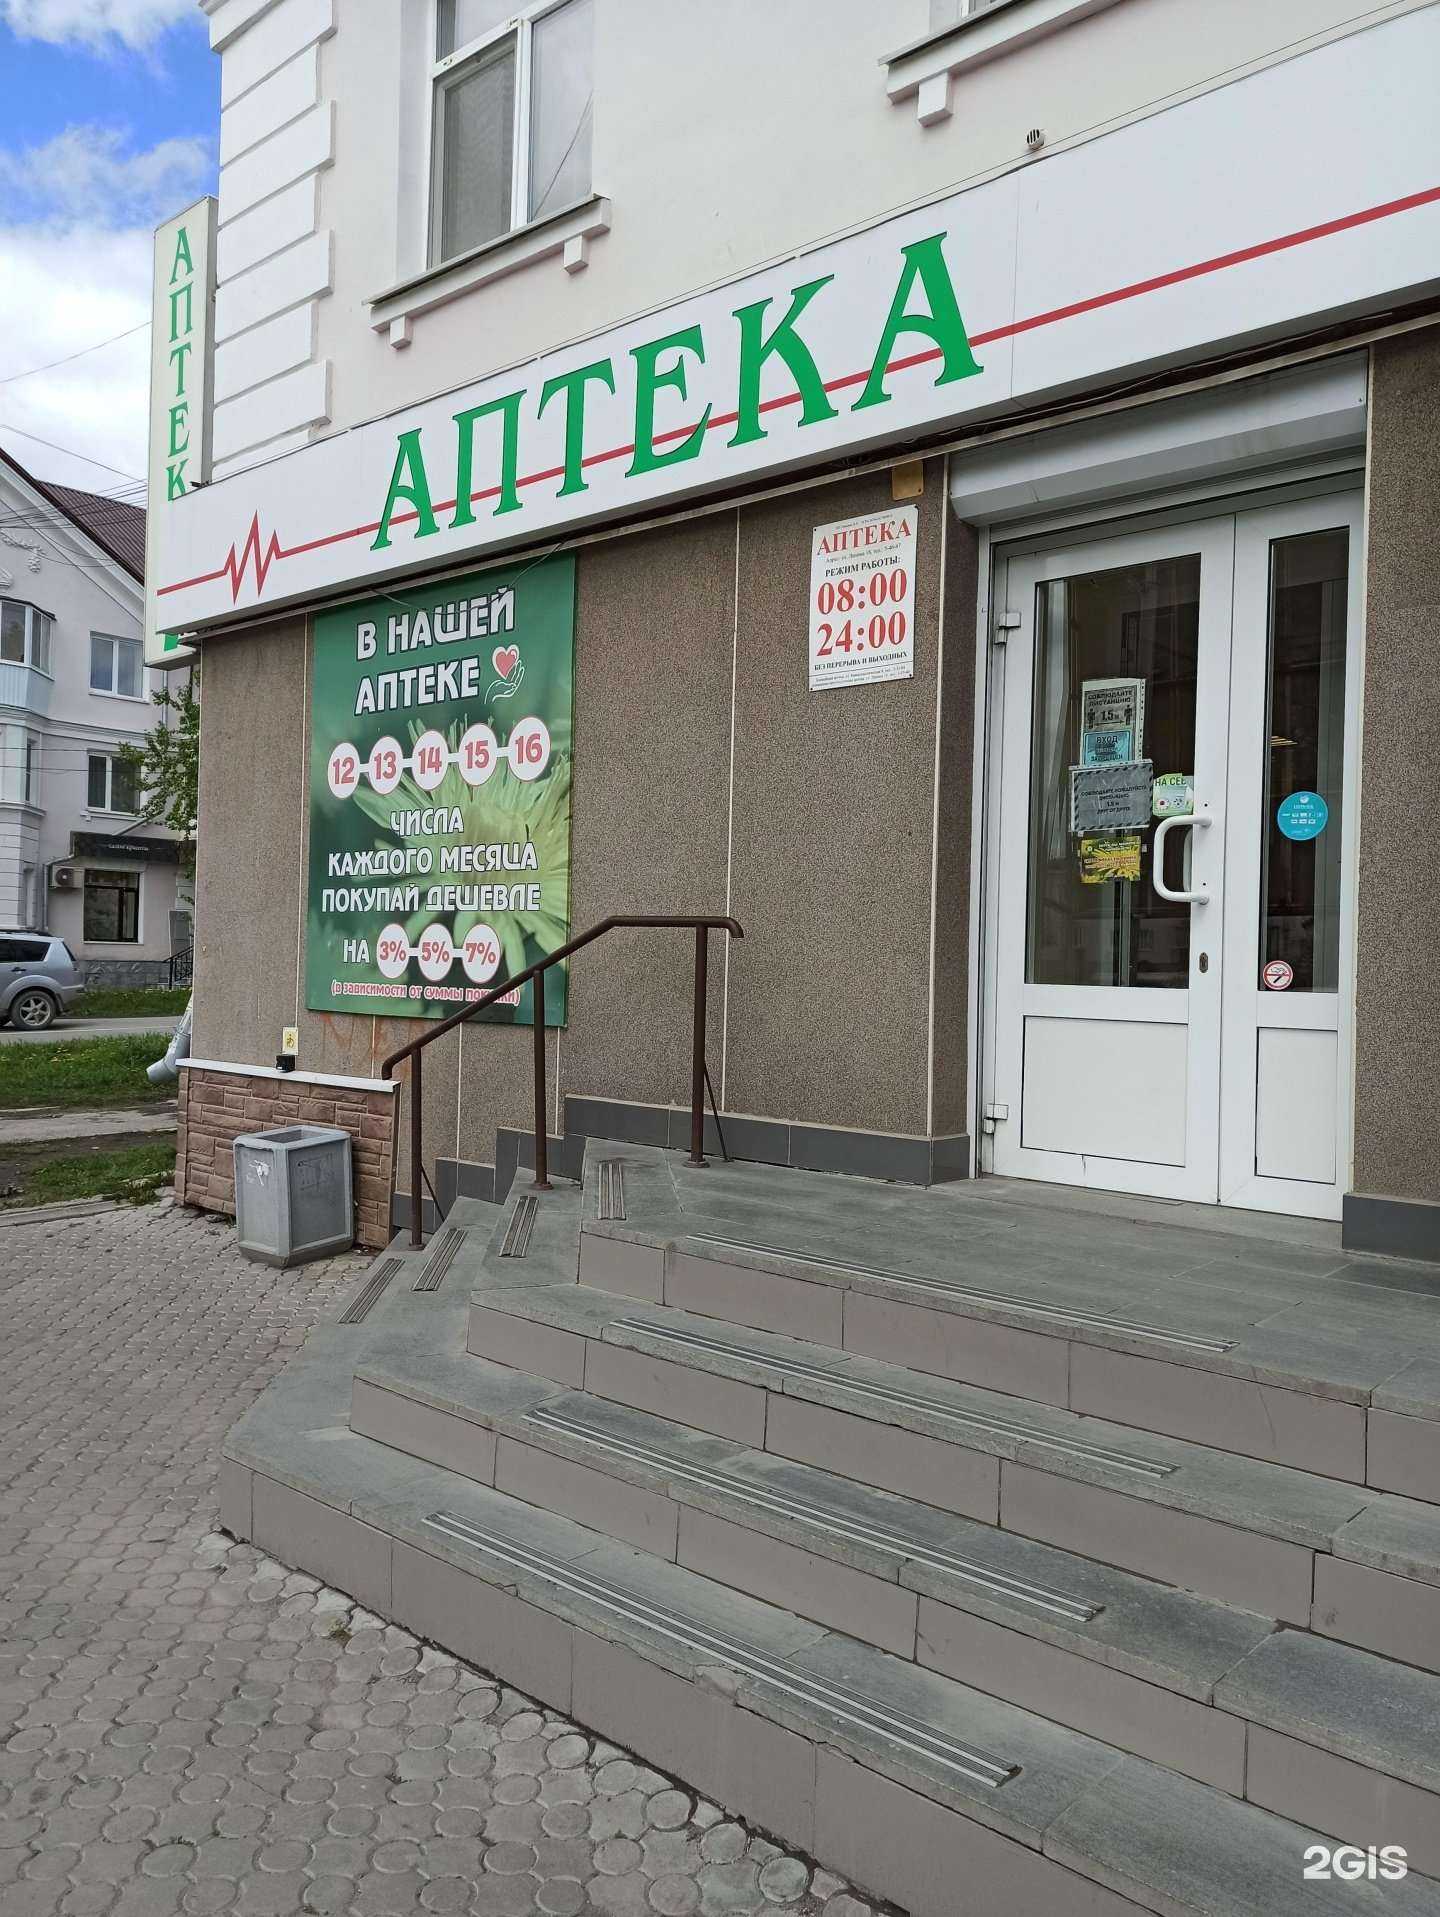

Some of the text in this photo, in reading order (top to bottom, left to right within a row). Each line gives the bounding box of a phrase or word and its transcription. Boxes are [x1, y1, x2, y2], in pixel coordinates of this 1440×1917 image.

[370, 231, 984, 551] АПТЕКА
[816, 518, 912, 556] АПТЕКА
[825, 555, 902, 578] РЕЖИМ РАБОТЫ:
[817, 568, 907, 615] 08:00
[356, 585, 515, 661] В НАШЕЙ
[817, 611, 906, 657] 24:00
[814, 662, 826, 671] БЕЗ
[826, 658, 861, 669] ПЕРЕРЫВА
[868, 651, 907, 663] ВЫХОДНЫХ
[354, 655, 480, 716] АПТЕКЕ
[1096, 735, 1118, 744] ВХОД
[332, 733, 543, 785] 12 13 14 15 16
[1155, 777, 1167, 787] НА
[390, 806, 464, 838] ЧИСЛА
[327, 841, 538, 877] КАЖДОГО МЕСЯЦА
[321, 883, 541, 913] ПОКУПАЙ ДЕШЕВЛЕ
[343, 939, 497, 965] НА 3% 5% 7%
[331, 980, 521, 1007] (в зависимости от суммы покки)
